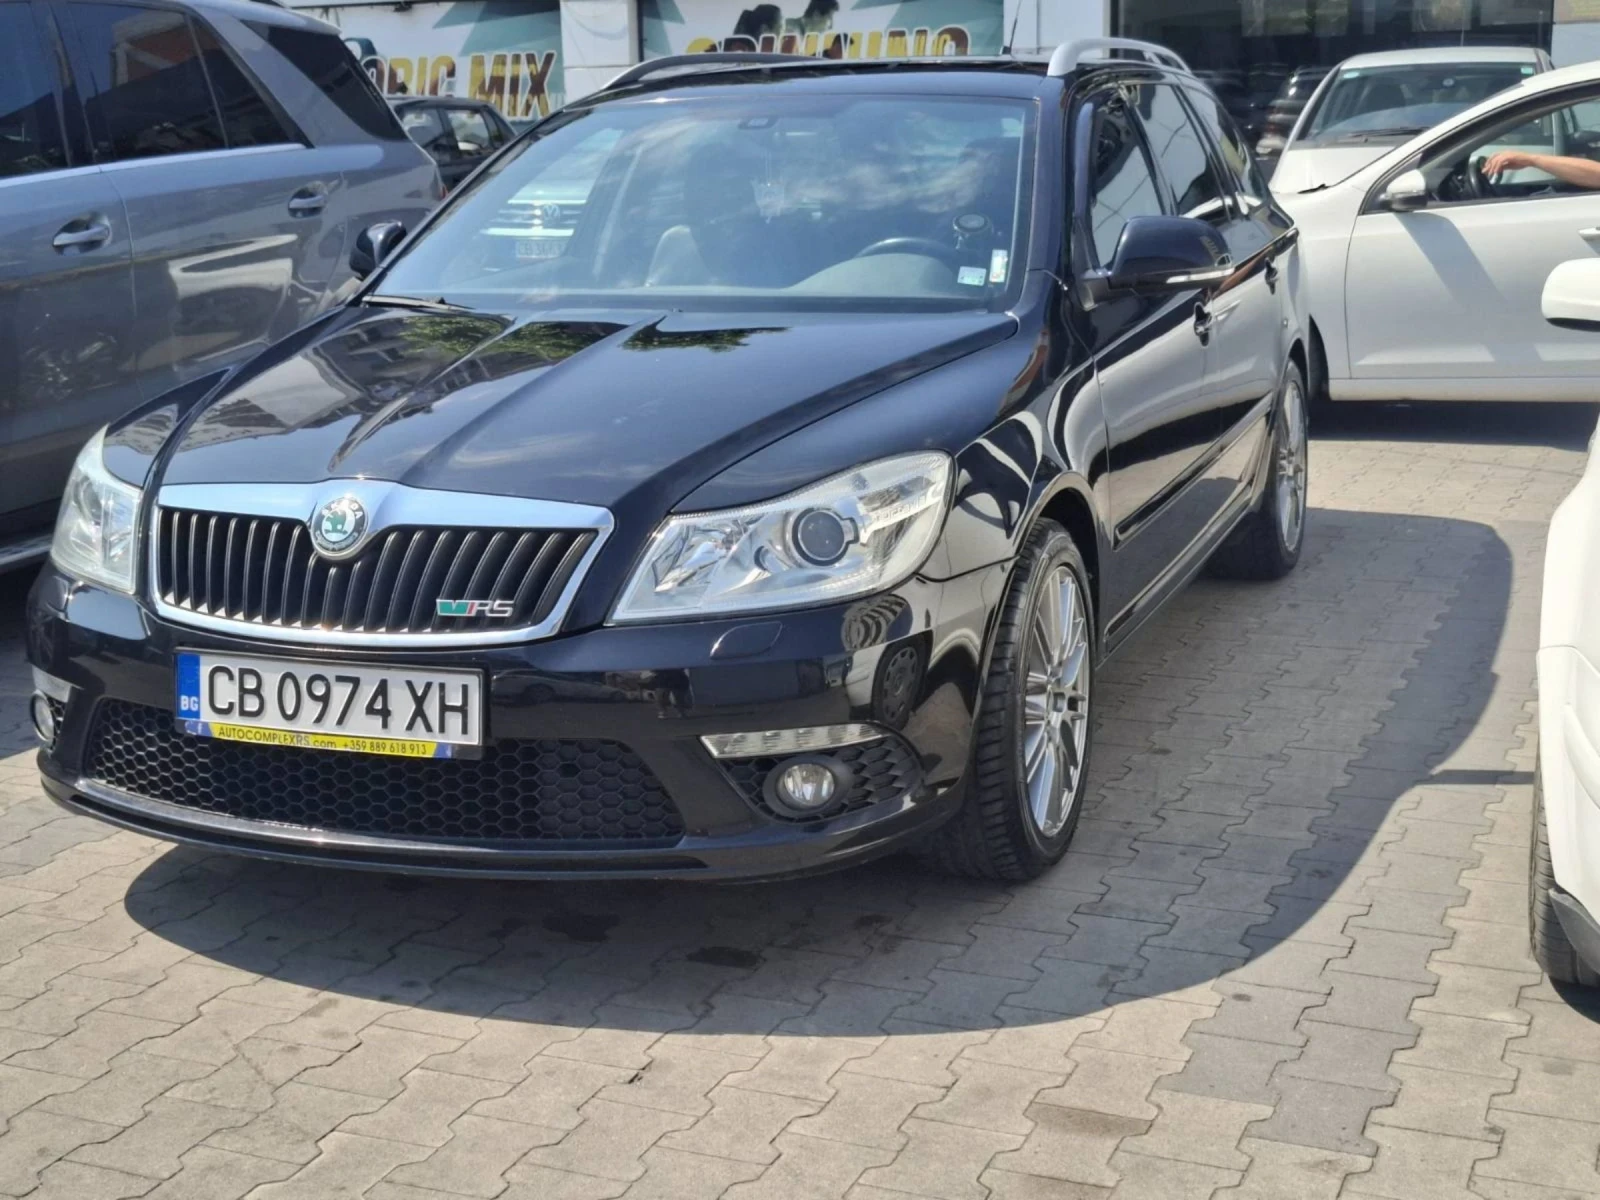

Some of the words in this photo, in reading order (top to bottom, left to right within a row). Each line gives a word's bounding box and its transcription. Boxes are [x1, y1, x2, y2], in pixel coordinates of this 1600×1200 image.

[467, 51, 556, 119] MIX
[181, 695, 199, 711] BG
[208, 665, 264, 717] CB
[277, 671, 391, 729] 0974
[405, 679, 469, 735] XH
[369, 741, 387, 752] 889
[389, 743, 407, 754] 618
[409, 744, 427, 755] 913
